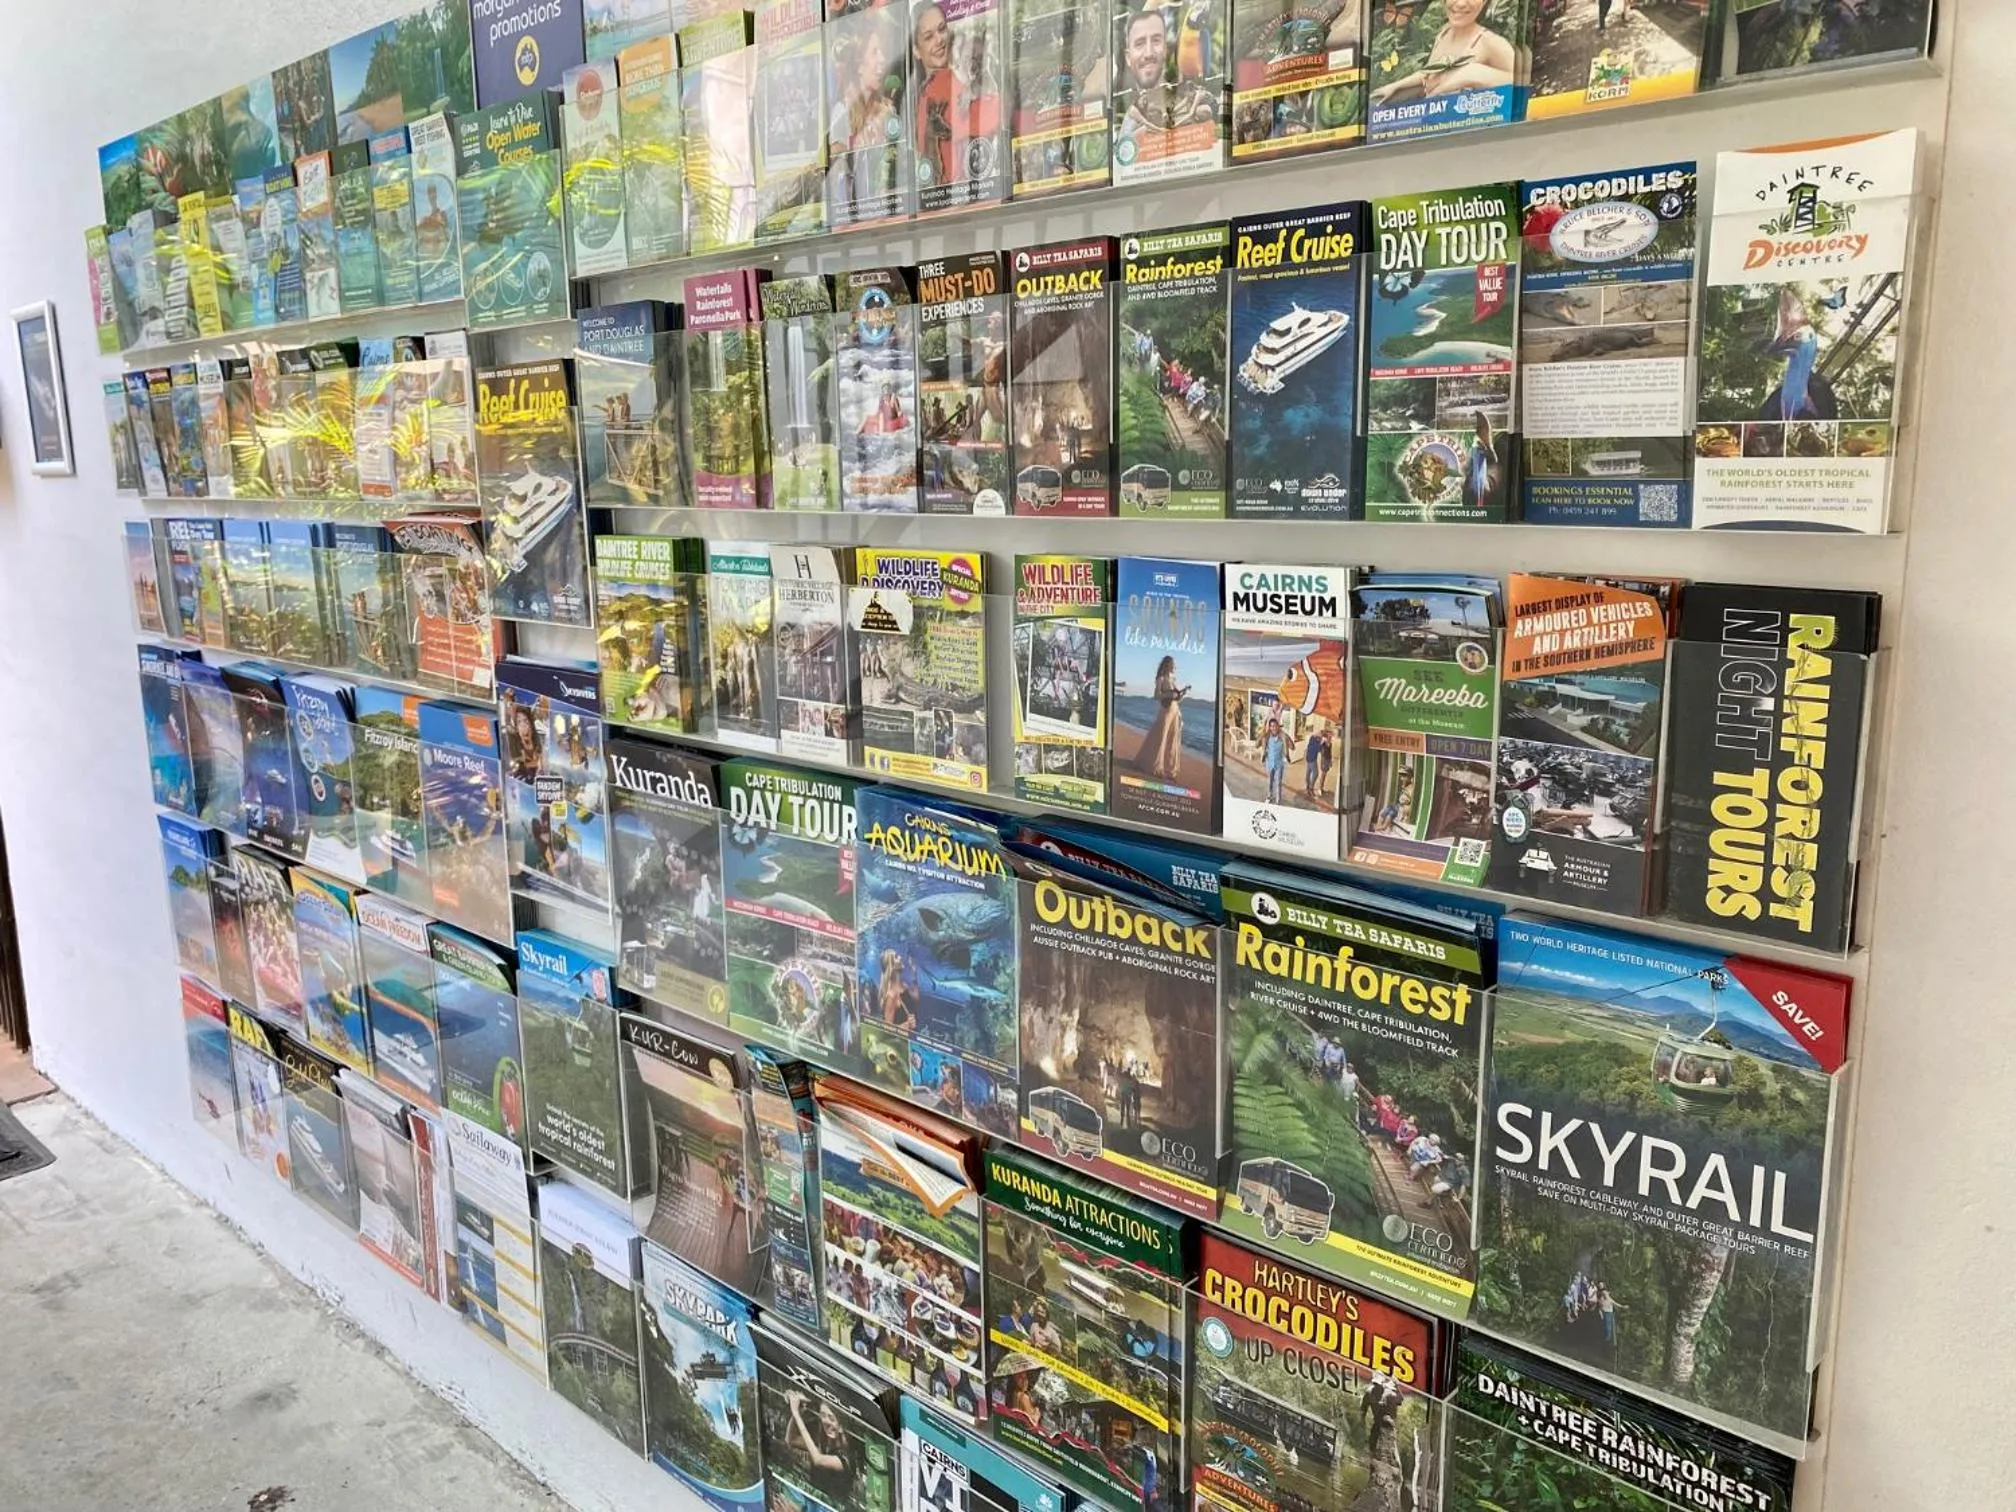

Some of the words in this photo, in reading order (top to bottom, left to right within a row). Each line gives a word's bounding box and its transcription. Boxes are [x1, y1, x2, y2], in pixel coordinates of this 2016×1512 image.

[490, 0, 562, 48] promotions
[1373, 108, 1396, 123] OPEN
[1397, 104, 1426, 120] EVERY
[1429, 101, 1448, 114] DAY
[486, 131, 512, 153] Open
[512, 121, 541, 142] Water
[1530, 170, 1685, 206] CROCODILES
[1755, 165, 1875, 203] DAINTREE
[1378, 205, 1418, 233] Cape
[1419, 195, 1506, 225] Tribulation
[1054, 252, 1068, 262] TEA
[1068, 247, 1103, 261] SAFARIS
[1143, 238, 1167, 251] BILLY
[1166, 235, 1184, 249] TEA
[1184, 231, 1223, 247] SAFARIS
[1236, 227, 1288, 270] Reef
[1290, 224, 1354, 264] Cruise
[1379, 229, 1428, 271] DAY
[1436, 221, 1508, 266] TOUR
[919, 262, 945, 279] THREE
[920, 267, 996, 303] MUST-DO
[1016, 269, 1104, 299] OUTBACK
[1125, 254, 1223, 284] Rainforest
[1478, 277, 1503, 291] VALUE
[695, 284, 732, 298] Waterfalls
[696, 297, 734, 311] Rainforest
[1483, 291, 1498, 302] TOUR
[921, 297, 985, 322] EXPERIENCES
[583, 329, 606, 342] PORT
[606, 325, 645, 339] DOUGLAS
[479, 381, 517, 415] Reef
[519, 378, 567, 410] Cruise
[1532, 486, 1583, 496] BOOKINGS
[1585, 486, 1634, 495] ESSENTIAL
[1706, 468, 1725, 478] THE
[1726, 468, 1774, 478] WORLD'S
[1775, 469, 1816, 478] OLDEST
[1818, 469, 1872, 478] TROPICAL
[1720, 480, 1784, 489] RAINFOREST
[1786, 480, 1825, 489] STARTS
[1827, 480, 1856, 489] HERE
[641, 540, 671, 561] RIVER
[876, 558, 939, 577] WILDLIFE
[1022, 563, 1093, 587] WILDLIFE
[1239, 572, 1329, 594] CAIRNS
[779, 588, 835, 604] HERBERTON
[1027, 585, 1102, 616] ADVENTURE
[1232, 591, 1337, 618] MUSEUM
[1514, 600, 1553, 617] LARGEST
[1554, 595, 1592, 612] DISPLAY
[1594, 591, 1605, 604] OF
[1514, 608, 1588, 638] ARMOURED
[1590, 602, 1653, 625] VEHICLES
[1511, 660, 1521, 673] IN
[1522, 656, 1541, 671] THE
[1542, 649, 1592, 669] SOUTHERN
[1594, 637, 1656, 661] HEMISPHERE
[1532, 635, 1560, 656] AND
[1562, 622, 1635, 648] ARTILLERY
[1374, 676, 1489, 708] Mareeba
[1714, 607, 1782, 762] NIGHT
[1373, 732, 1393, 741] FREE
[1394, 734, 1421, 746] ENTRY
[433, 750, 463, 769] Moore
[464, 755, 485, 774] Reef
[1769, 612, 1836, 934] RAINFOREST
[610, 753, 713, 810] Kuranda
[745, 771, 774, 791] CAPE
[775, 776, 843, 803] TRIBULATION
[729, 786, 781, 833] DAY
[788, 796, 858, 846] TOUR
[864, 821, 1008, 883] AQUARIUM
[1705, 767, 1771, 922] TOURS
[1172, 865, 1196, 878] BILLY
[1198, 870, 1217, 882] TEA
[1173, 876, 1218, 894] SAFARIS
[1562, 870, 1609, 886] ARTILLERY
[1563, 862, 1601, 875] ARMOUR
[1034, 879, 1212, 959] Outback
[1286, 906, 1329, 929] BILLY
[1333, 918, 1367, 940] TEA
[1369, 928, 1447, 960] SAFARIS
[519, 941, 569, 977] Skyrail
[1030, 923, 1073, 941] INCLUDING
[1074, 932, 1118, 951] CHILLAGOE
[1148, 949, 1184, 965] GRANITE
[1184, 957, 1217, 973] GORGE
[1033, 936, 1060, 949] AUSSIE
[1061, 941, 1097, 958] OUTBACK
[1098, 950, 1114, 961] PUB
[1121, 955, 1173, 974] ABORIGINAL
[1173, 966, 1198, 981] ROCK
[1199, 973, 1216, 985] ART
[1510, 930, 1530, 942] TWO
[1532, 934, 1564, 949] WORLD
[1566, 941, 1610, 960] HERITAGE
[1611, 950, 1644, 967] LISTED
[1645, 957, 1693, 976] NATIONAL
[1697, 969, 1730, 985] PARKS
[1235, 922, 1472, 1026] Rainforest
[1250, 991, 1275, 1006] RIVER
[1276, 998, 1308, 1017] CRUISE
[1317, 1010, 1341, 1026] 4WD
[1341, 1017, 1361, 1032] THE
[1361, 1022, 1425, 1050] BLOOMFIELD
[1425, 1041, 1459, 1059] TRACK
[1254, 980, 1306, 1003] INCLUDING
[1356, 1007, 1383, 1024] CAPE
[1383, 1015, 1453, 1045] TRIBULATION,
[1771, 990, 1824, 1042] SAVE!
[461, 1121, 512, 1166] Sailaway
[538, 1120, 572, 1149] tropical
[572, 1140, 616, 1172] rainforest
[546, 1114, 580, 1138] world's
[578, 1128, 606, 1151] oldest
[1162, 1137, 1196, 1163] ECO
[1495, 1101, 1815, 1244] SKYRAIL
[991, 1162, 1062, 1209] KURANDA
[1064, 1193, 1162, 1251] ATTRACTIONS
[1495, 1164, 1530, 1184] SKYRAIL
[1532, 1173, 1587, 1198] RAINFOREST
[1589, 1189, 1640, 1212] CABLEWAY
[1641, 1204, 1664, 1218] AND
[1666, 1211, 1700, 1228] OUTER
[1702, 1220, 1735, 1237] GREAT
[1737, 1230, 1781, 1251] BARRIER
[1783, 1242, 1811, 1260] REEF
[1537, 1186, 1561, 1202] SAVE
[1562, 1192, 1578, 1205] ON
[1579, 1196, 1630, 1219] MULTI-DAY
[1632, 1210, 1672, 1231] SKYRAIL
[1674, 1223, 1719, 1245] PACKAGE
[1722, 1236, 1756, 1256] TOURS
[1409, 1223, 1453, 1252] ECO
[1254, 1260, 1360, 1322] HARTLEY'S
[1204, 1267, 1416, 1384] CROCODILES
[1245, 1335, 1275, 1366] UP
[1282, 1346, 1359, 1397] CLOSE!
[921, 1439, 968, 1481] CAIRNS
[1478, 1372, 1598, 1438] DAINTREE
[1601, 1421, 1772, 1512] RAINFOREST
[1533, 1419, 1583, 1454] CAPE
[1584, 1442, 1725, 1512] TRIBULATION
